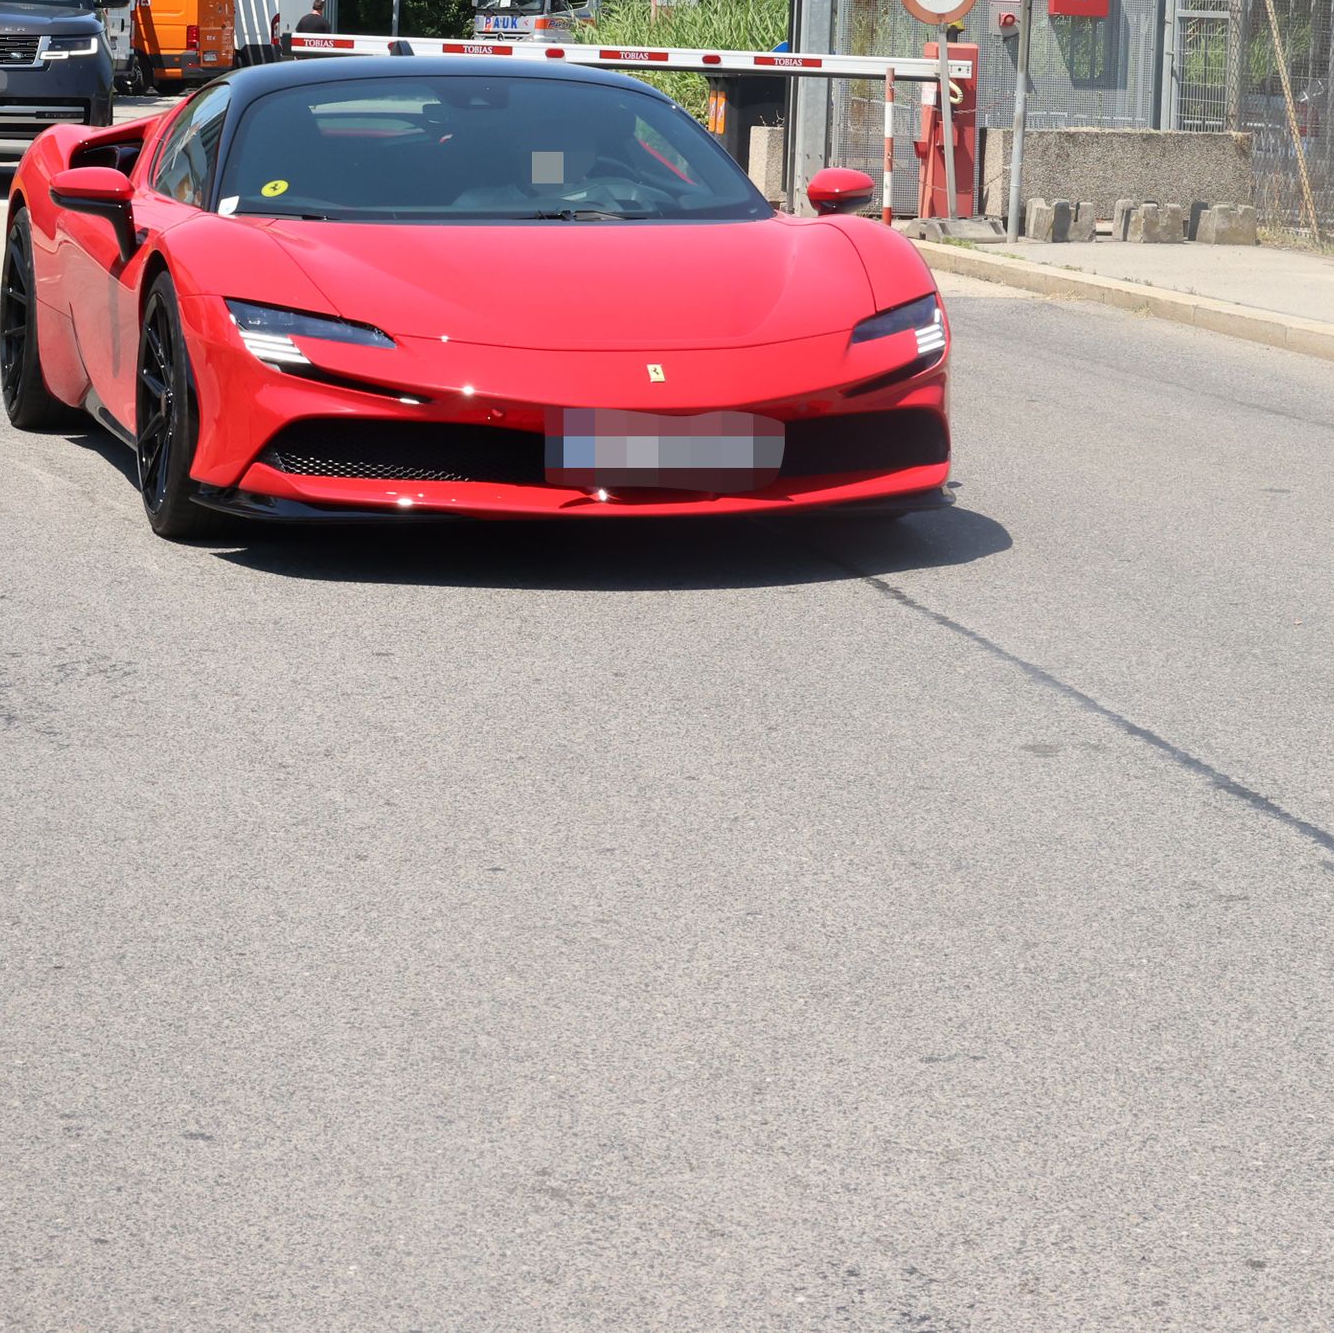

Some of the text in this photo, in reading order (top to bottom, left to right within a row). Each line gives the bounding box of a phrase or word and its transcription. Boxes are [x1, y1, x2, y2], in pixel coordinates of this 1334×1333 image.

[484, 16, 519, 30] PAUK
[303, 38, 334, 48] TOBIAS
[462, 45, 494, 55] TOBIAS
[619, 51, 649, 61] TOBIAS
[773, 57, 803, 67] TOBIAS
